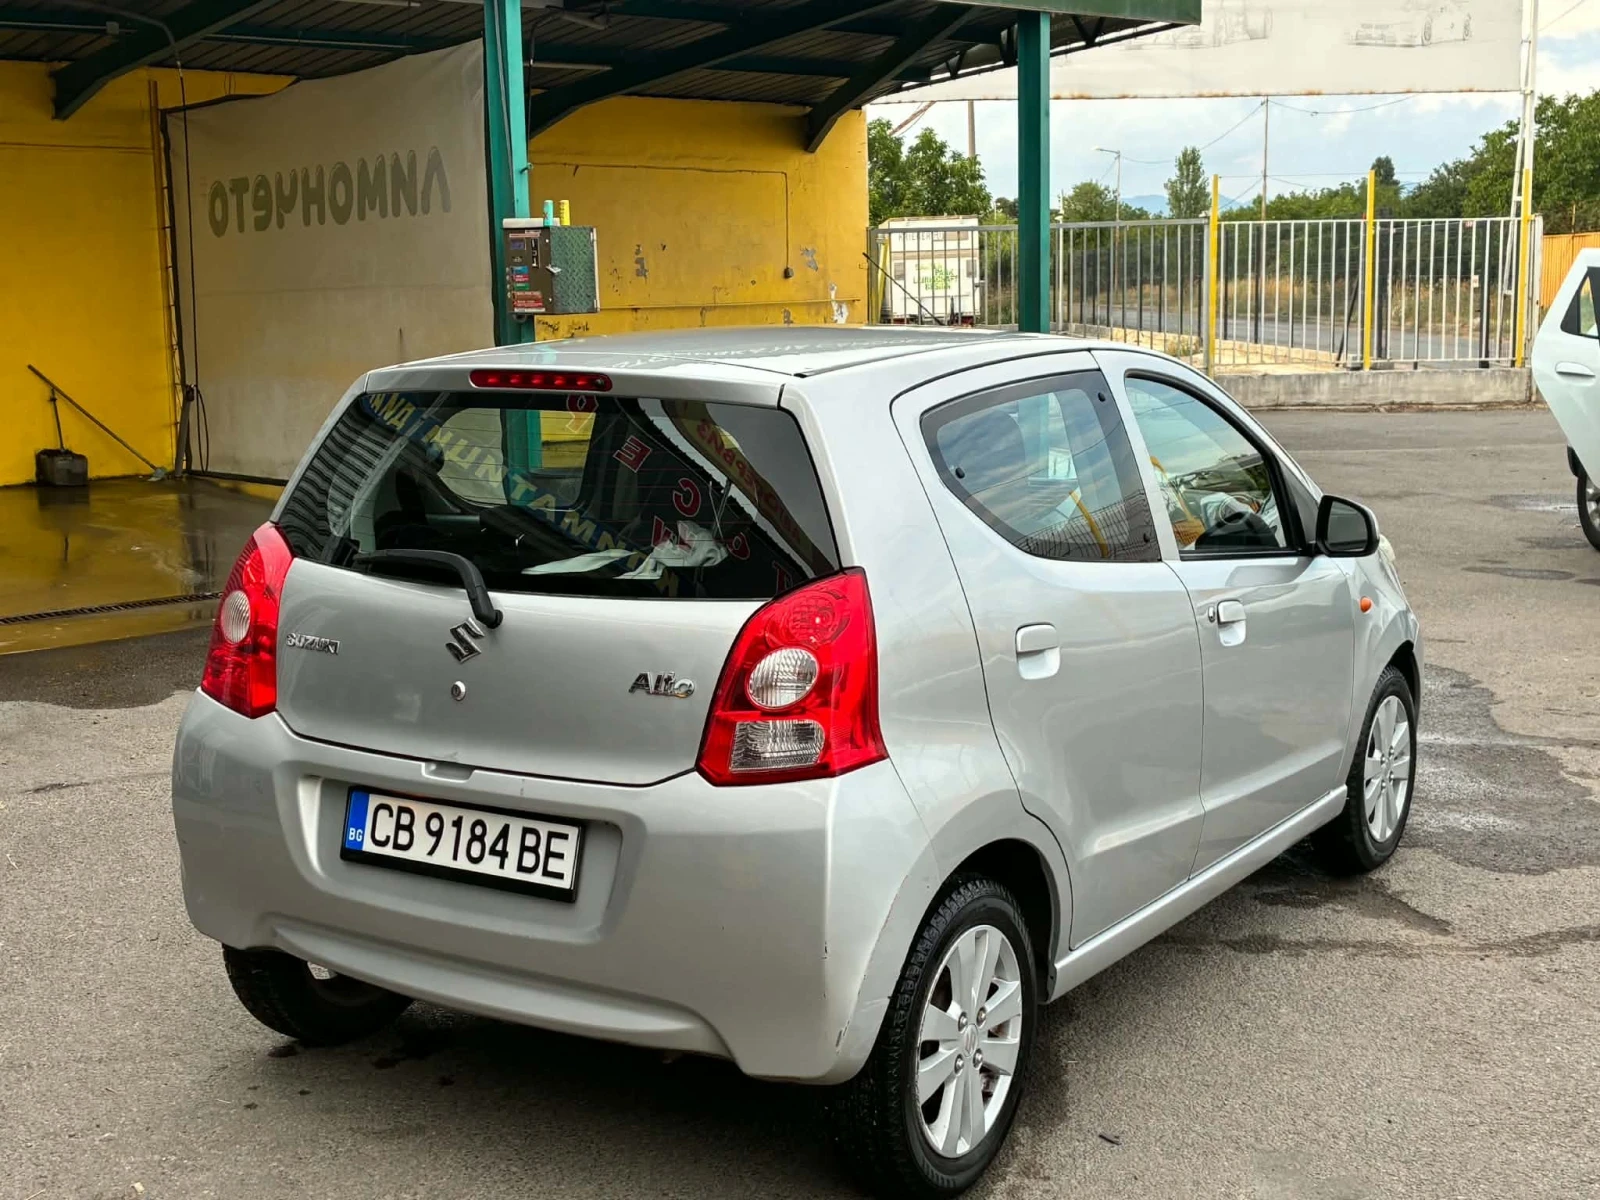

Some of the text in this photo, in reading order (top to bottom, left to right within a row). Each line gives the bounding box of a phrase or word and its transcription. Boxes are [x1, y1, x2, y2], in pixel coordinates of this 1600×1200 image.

[286, 632, 341, 655] SUZUKI
[628, 670, 696, 699] Alto
[348, 828, 364, 842] BG
[371, 803, 570, 880] CB 9184 BE
